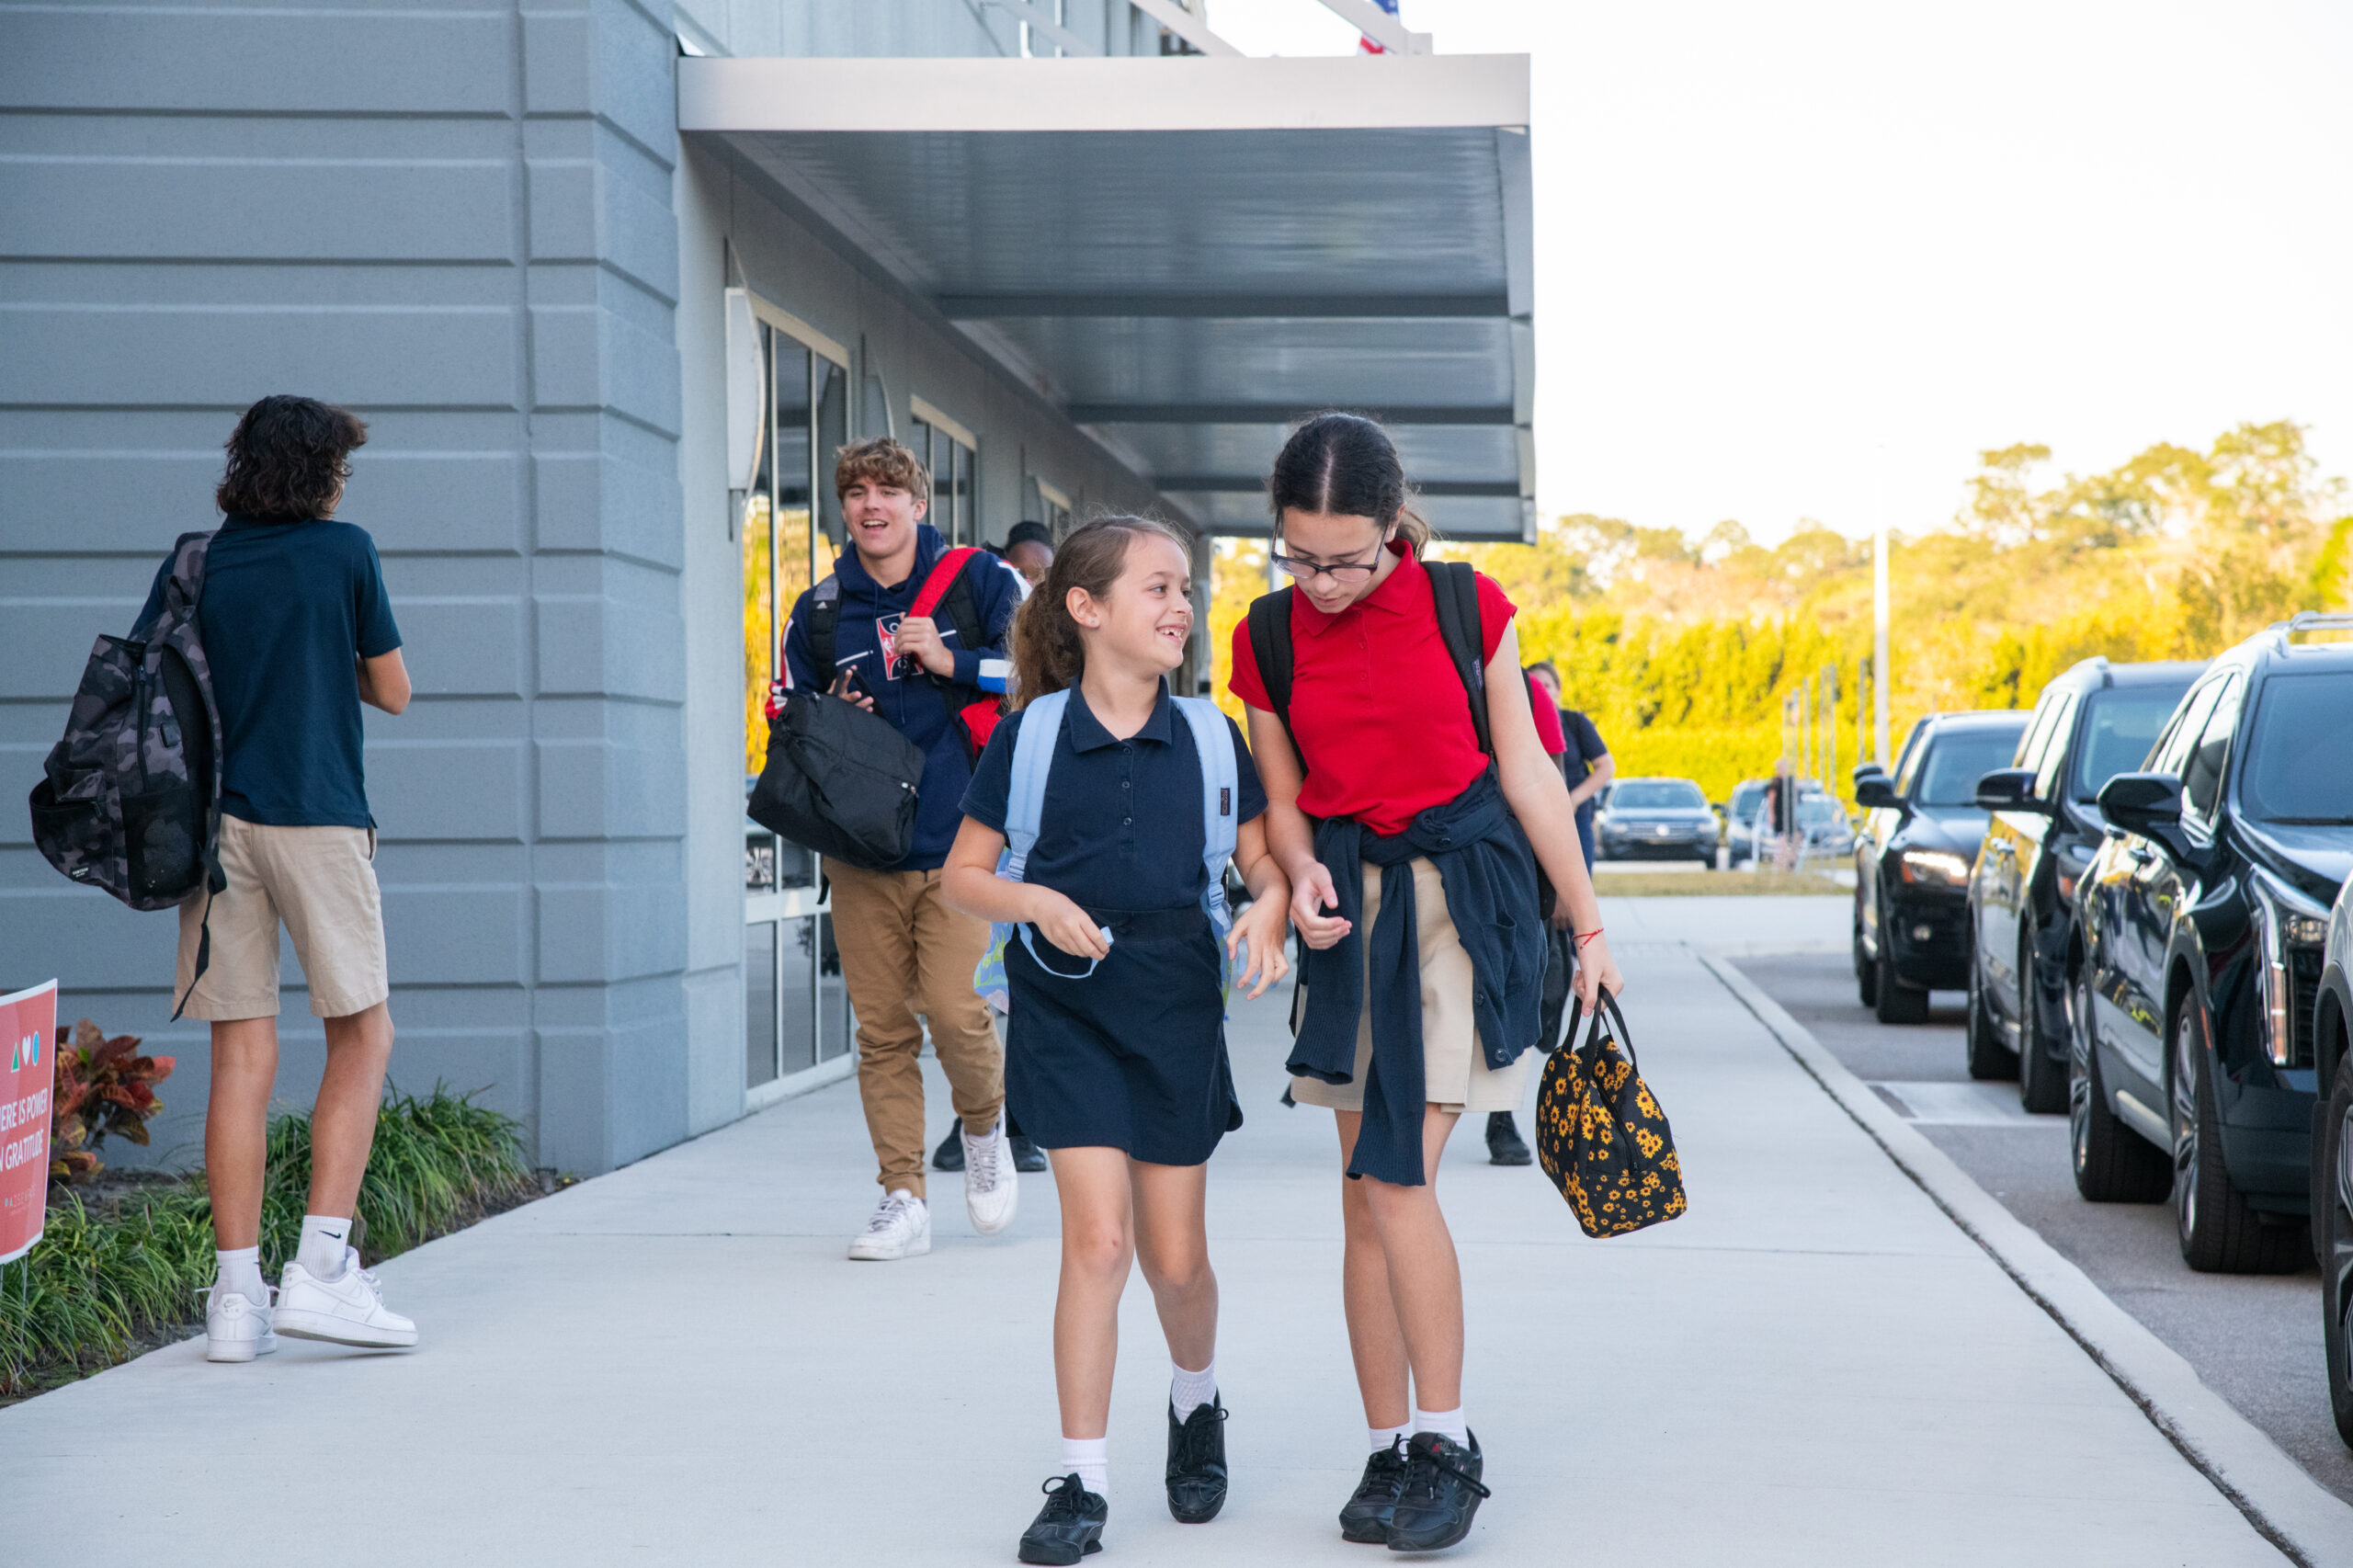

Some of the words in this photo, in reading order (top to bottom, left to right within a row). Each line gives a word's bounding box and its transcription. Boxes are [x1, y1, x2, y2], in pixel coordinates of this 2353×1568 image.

[0, 1101, 17, 1132] ERE
[18, 1098, 26, 1125] IS
[27, 1087, 48, 1122] POWER
[6, 1128, 44, 1170] GRATITUDE
